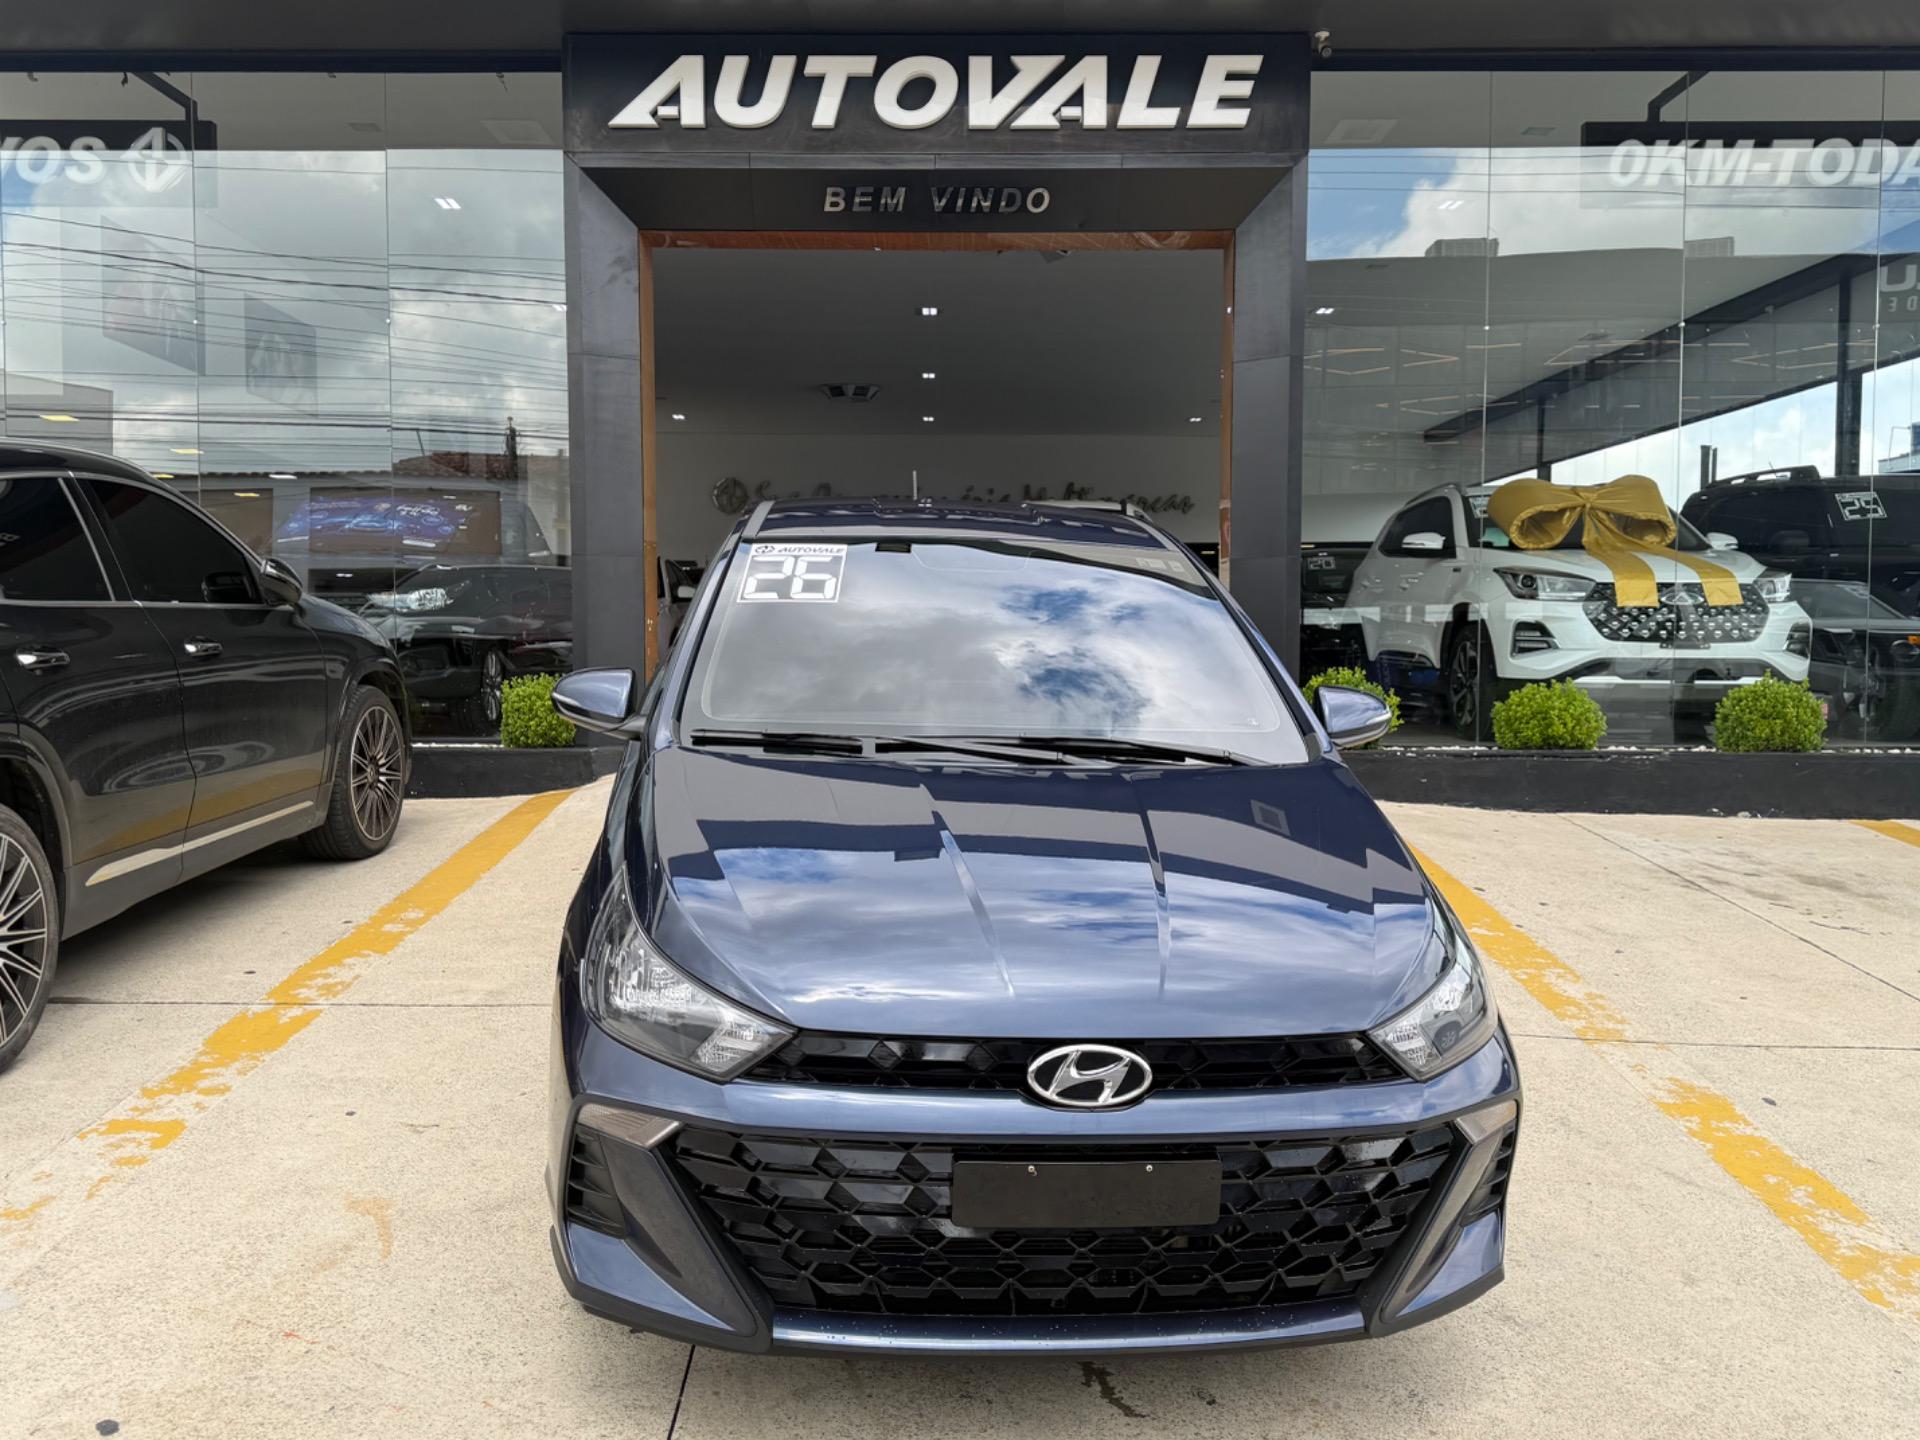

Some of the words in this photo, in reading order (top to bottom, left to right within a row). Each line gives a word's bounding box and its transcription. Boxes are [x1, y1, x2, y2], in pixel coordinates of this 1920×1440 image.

[608, 54, 1264, 130] AUTOVALE
[823, 186, 906, 212] BEM
[930, 186, 1050, 213] VINDO
[1839, 497, 1885, 519] 25
[777, 546, 845, 554] AUTOVALE
[743, 555, 838, 600] 26
